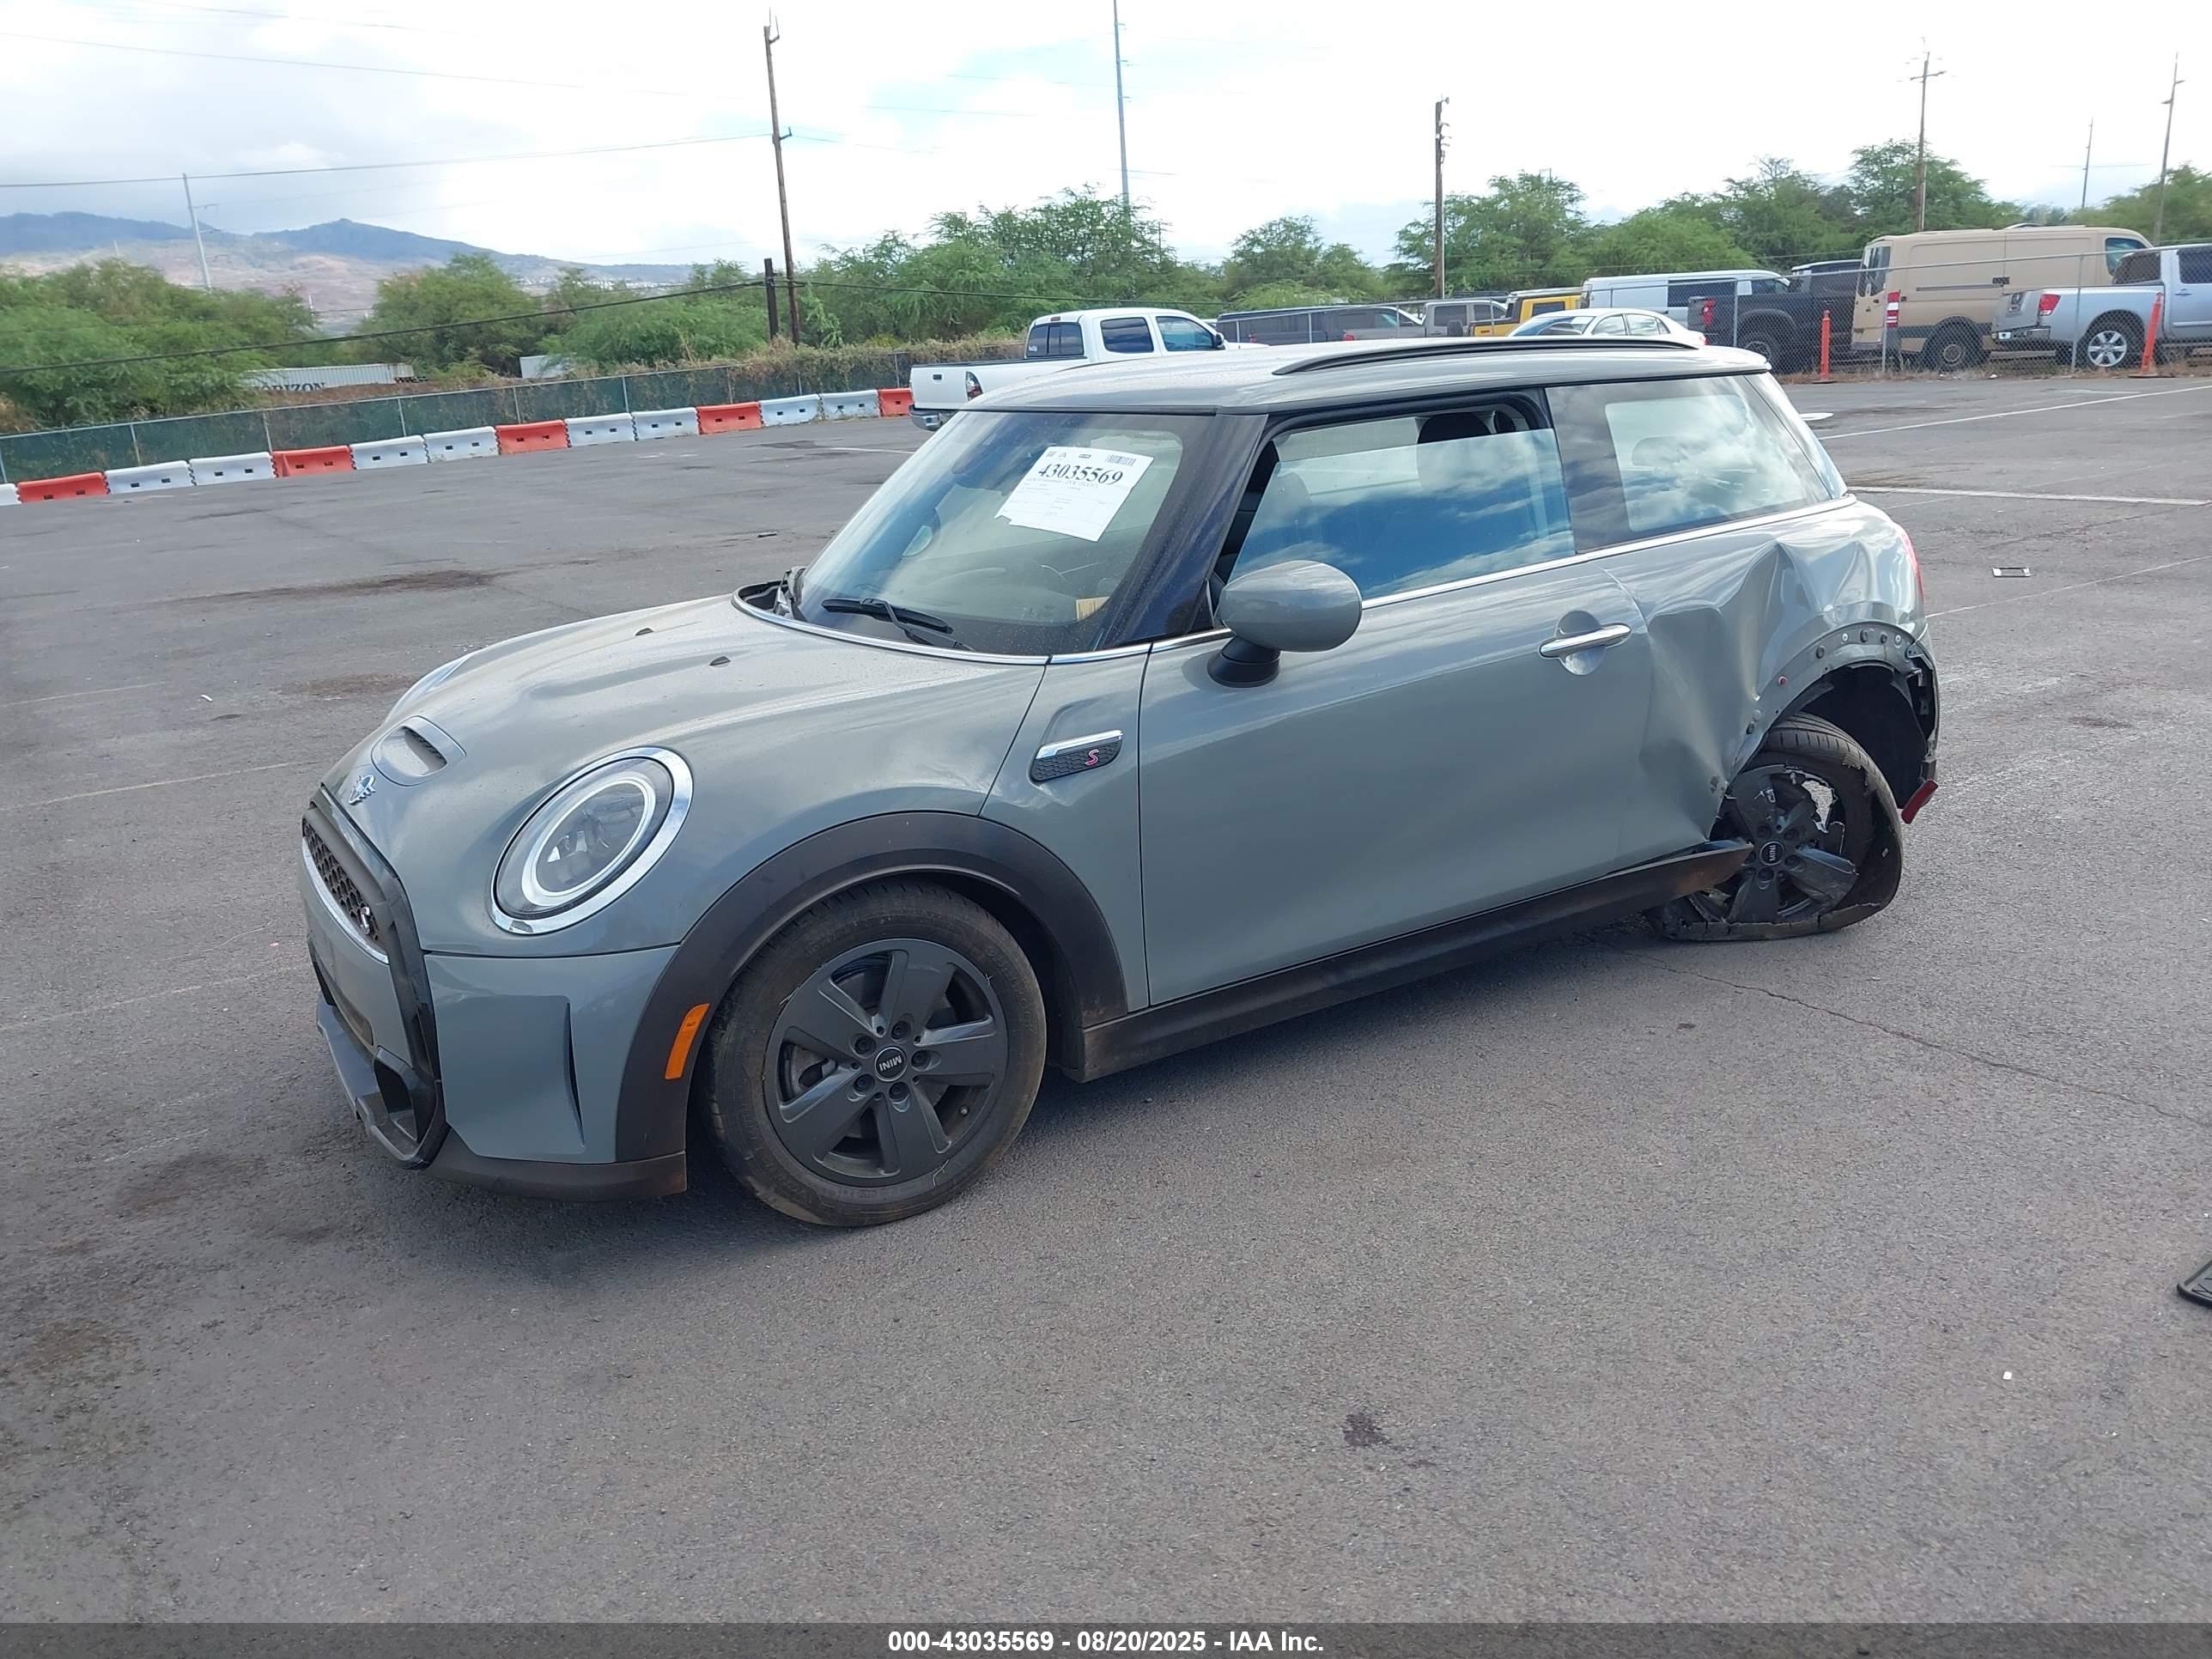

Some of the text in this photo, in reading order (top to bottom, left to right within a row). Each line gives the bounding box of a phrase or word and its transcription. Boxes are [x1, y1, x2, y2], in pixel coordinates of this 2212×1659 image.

[1038, 463, 1123, 485] 43035569
[1085, 749, 1099, 766] S
[879, 1055, 902, 1072] MINI
